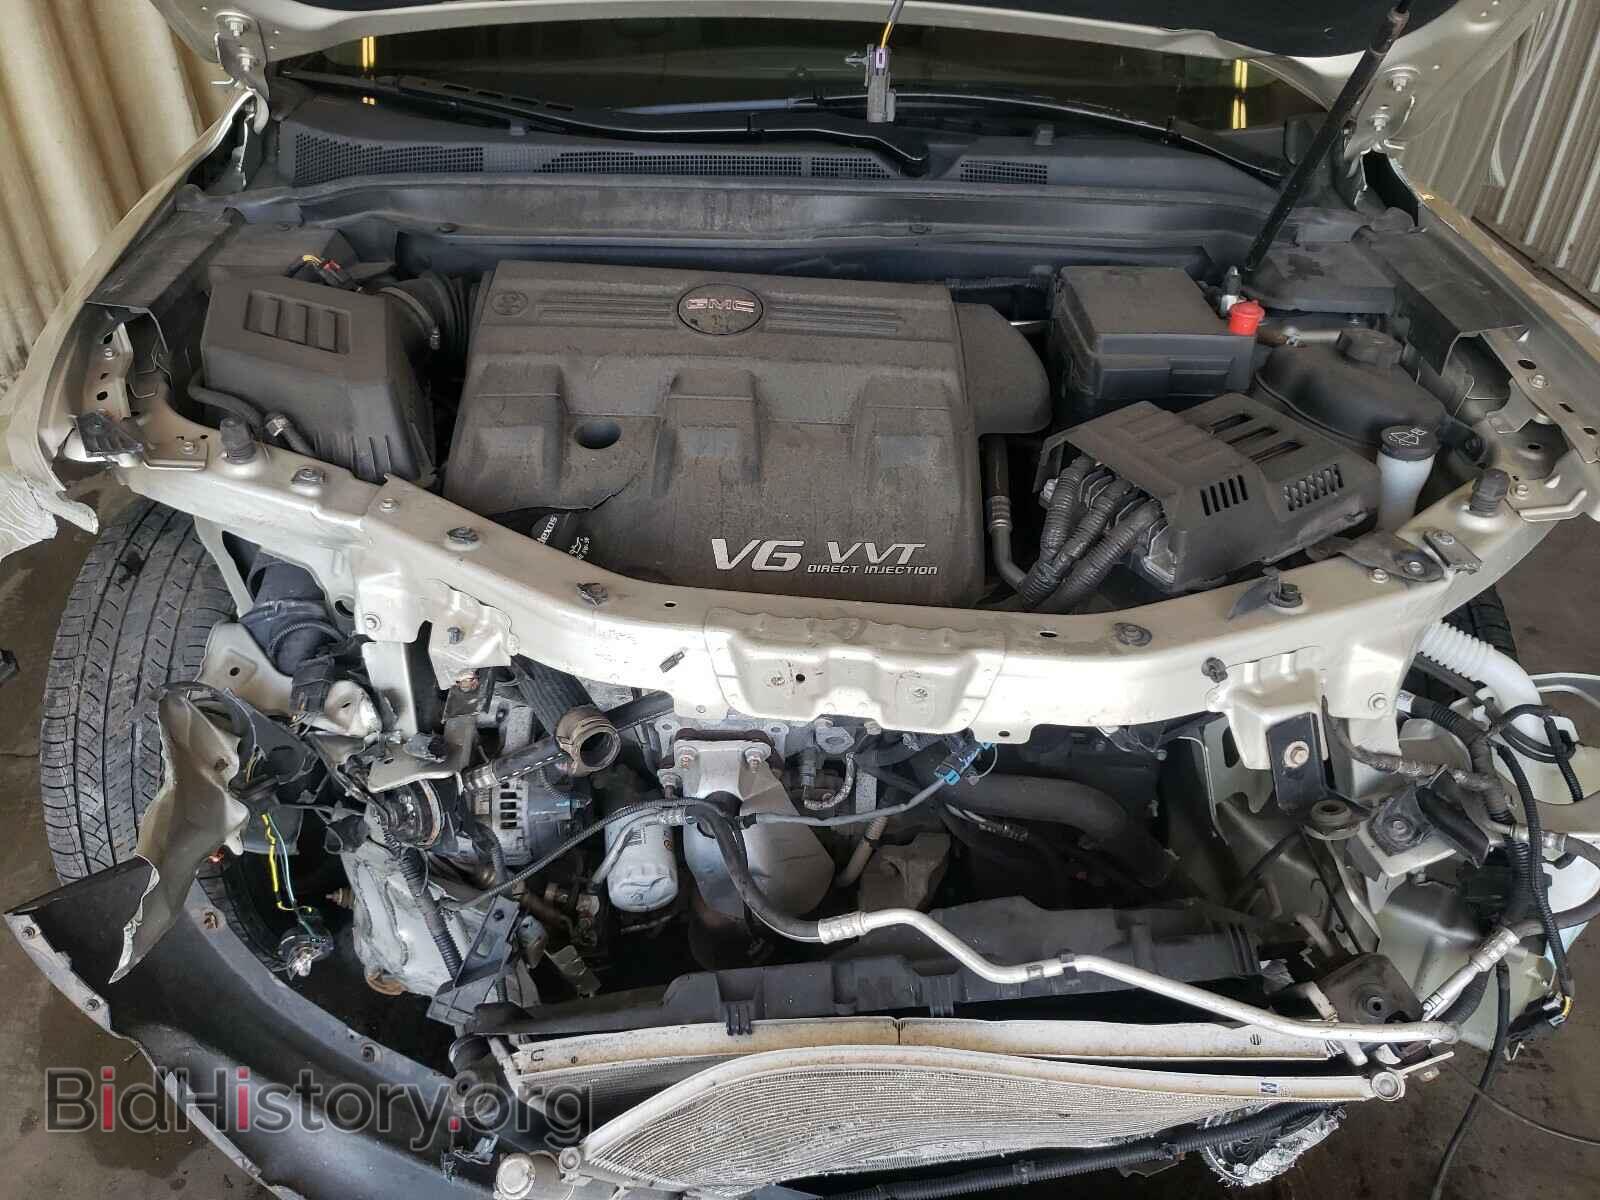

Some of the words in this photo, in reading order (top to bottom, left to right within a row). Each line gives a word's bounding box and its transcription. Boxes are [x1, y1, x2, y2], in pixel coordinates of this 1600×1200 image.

[687, 298, 755, 313] GMC
[711, 538, 804, 572] V6
[827, 541, 926, 565] VVT
[807, 564, 859, 573] DIRECT
[864, 565, 938, 575] INJECTION
